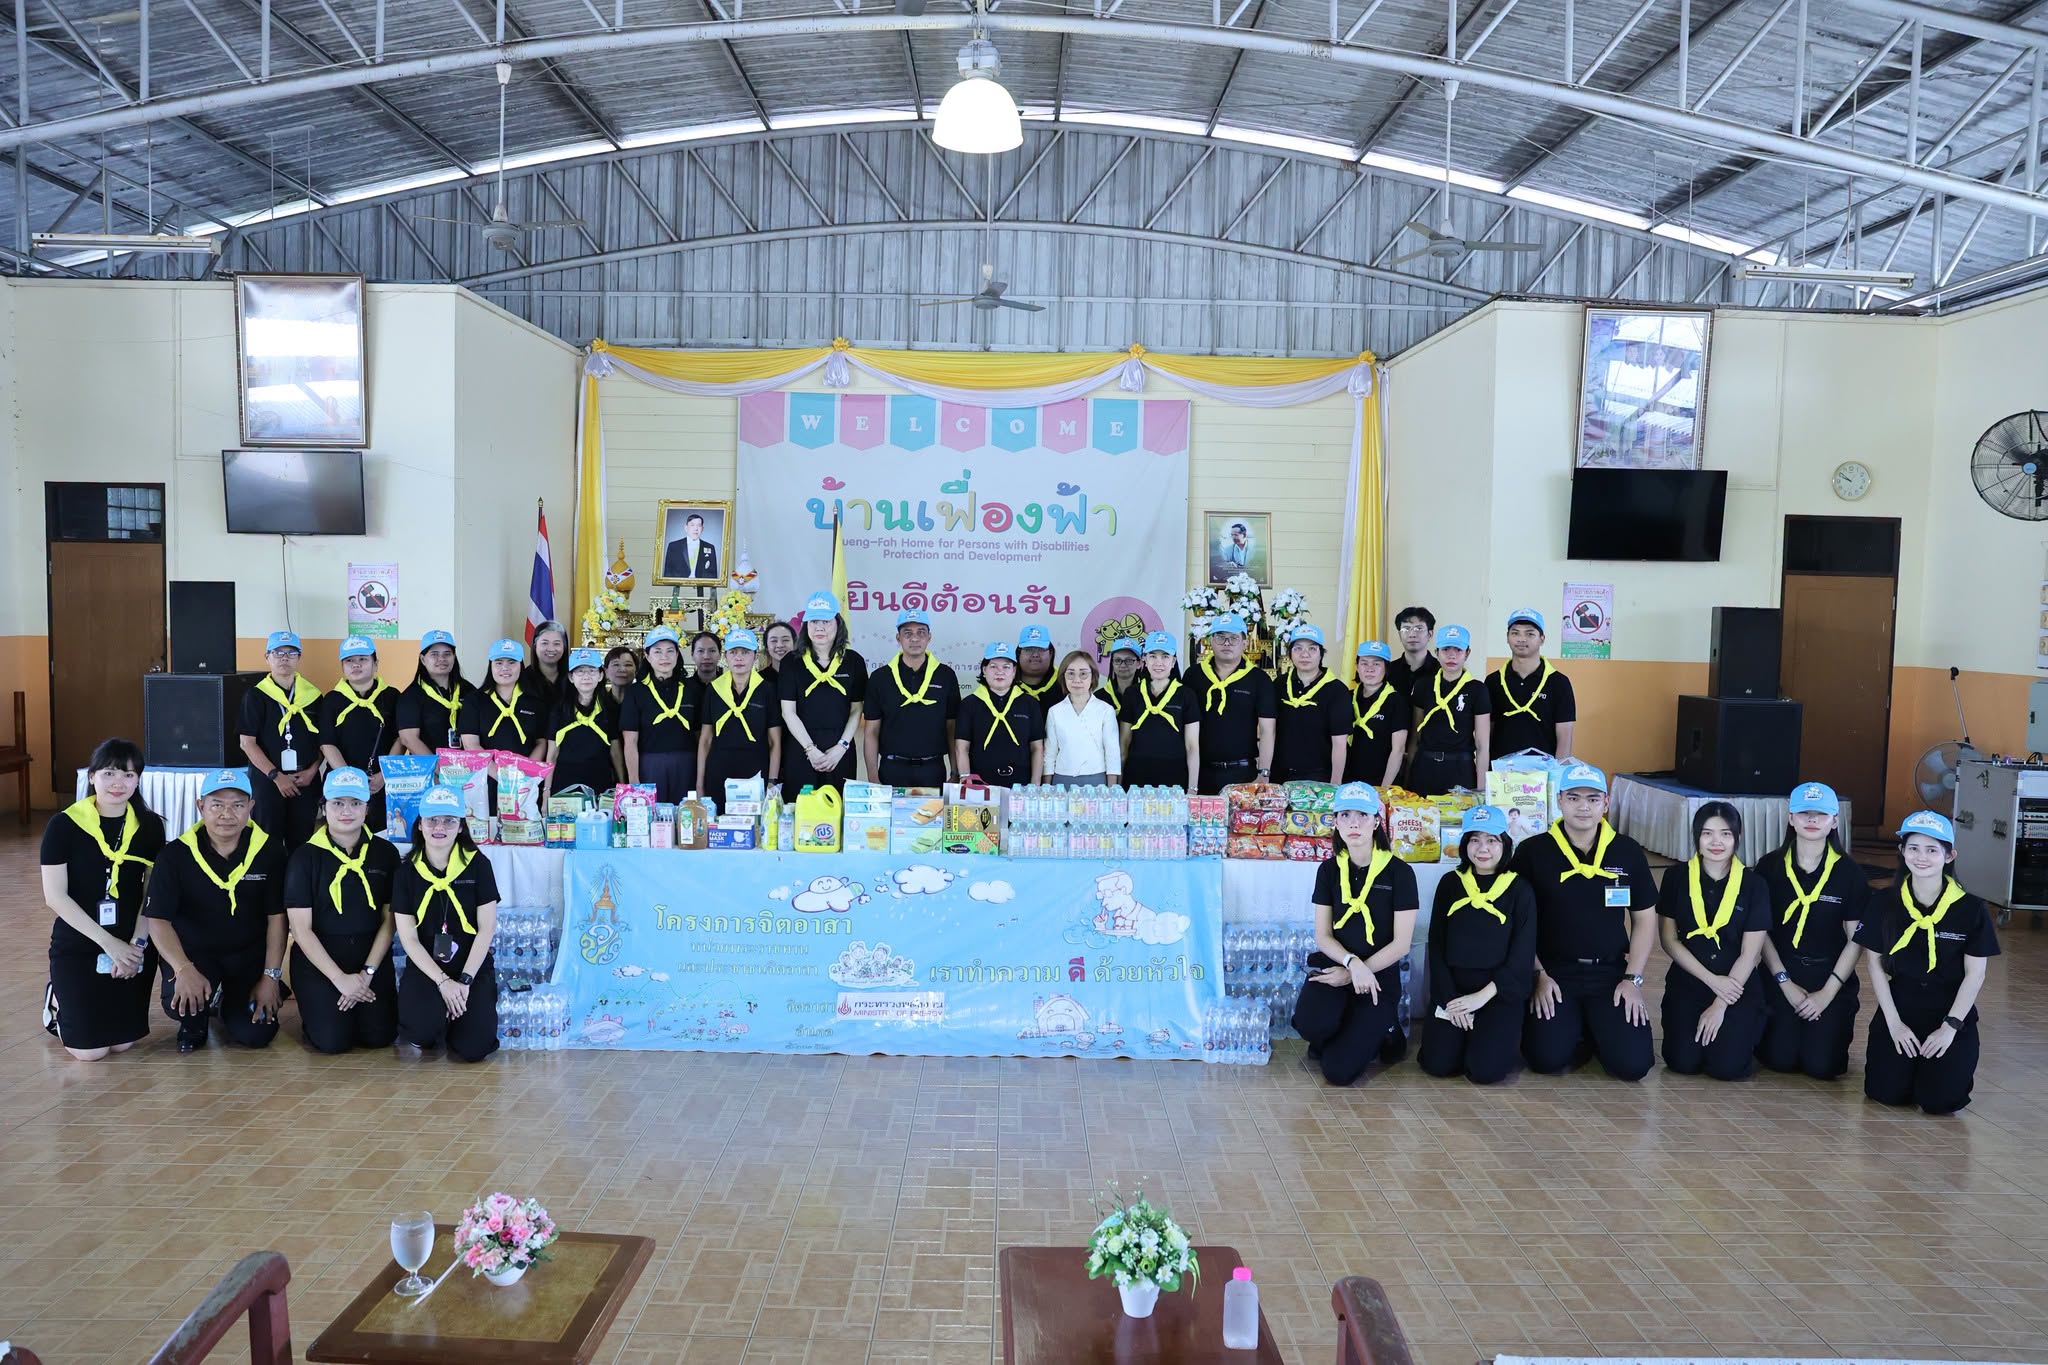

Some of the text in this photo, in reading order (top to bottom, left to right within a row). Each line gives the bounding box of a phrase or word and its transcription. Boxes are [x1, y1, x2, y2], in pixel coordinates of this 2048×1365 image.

[806, 468, 1117, 536] บ้านเฟื่องฟ้า
[842, 537, 1090, 551] ueng-Fah Home for Persons with Disabilities
[883, 549, 1042, 563] Protection and Development
[847, 581, 1070, 616] ยินดีต้อนรับ
[653, 904, 852, 935] โครงการจิตอาสา
[929, 955, 1205, 983] เราทำความ ดี ด้วยหัวใจ
